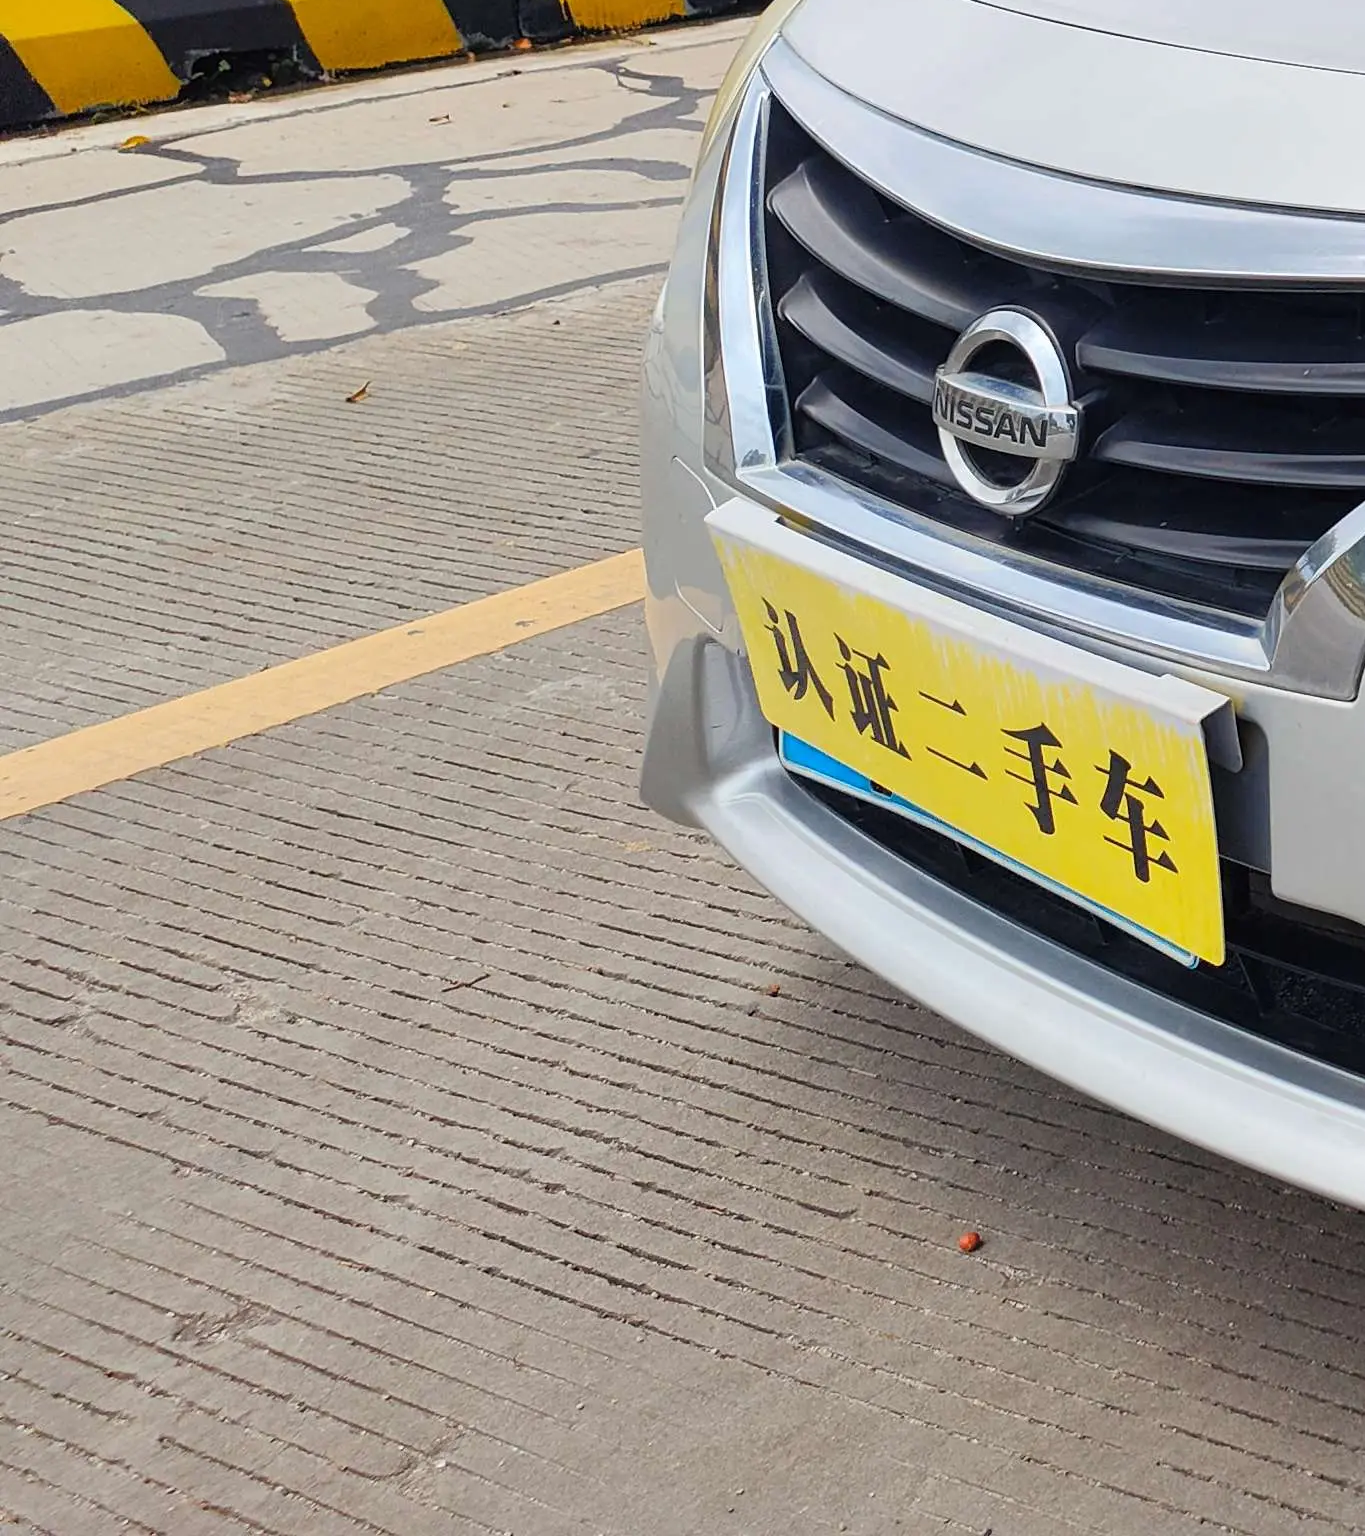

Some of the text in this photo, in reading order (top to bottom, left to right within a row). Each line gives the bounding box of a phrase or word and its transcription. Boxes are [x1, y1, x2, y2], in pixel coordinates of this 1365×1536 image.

[934, 386, 1048, 448] NISSAN
[762, 597, 1179, 884] 认证二手车
